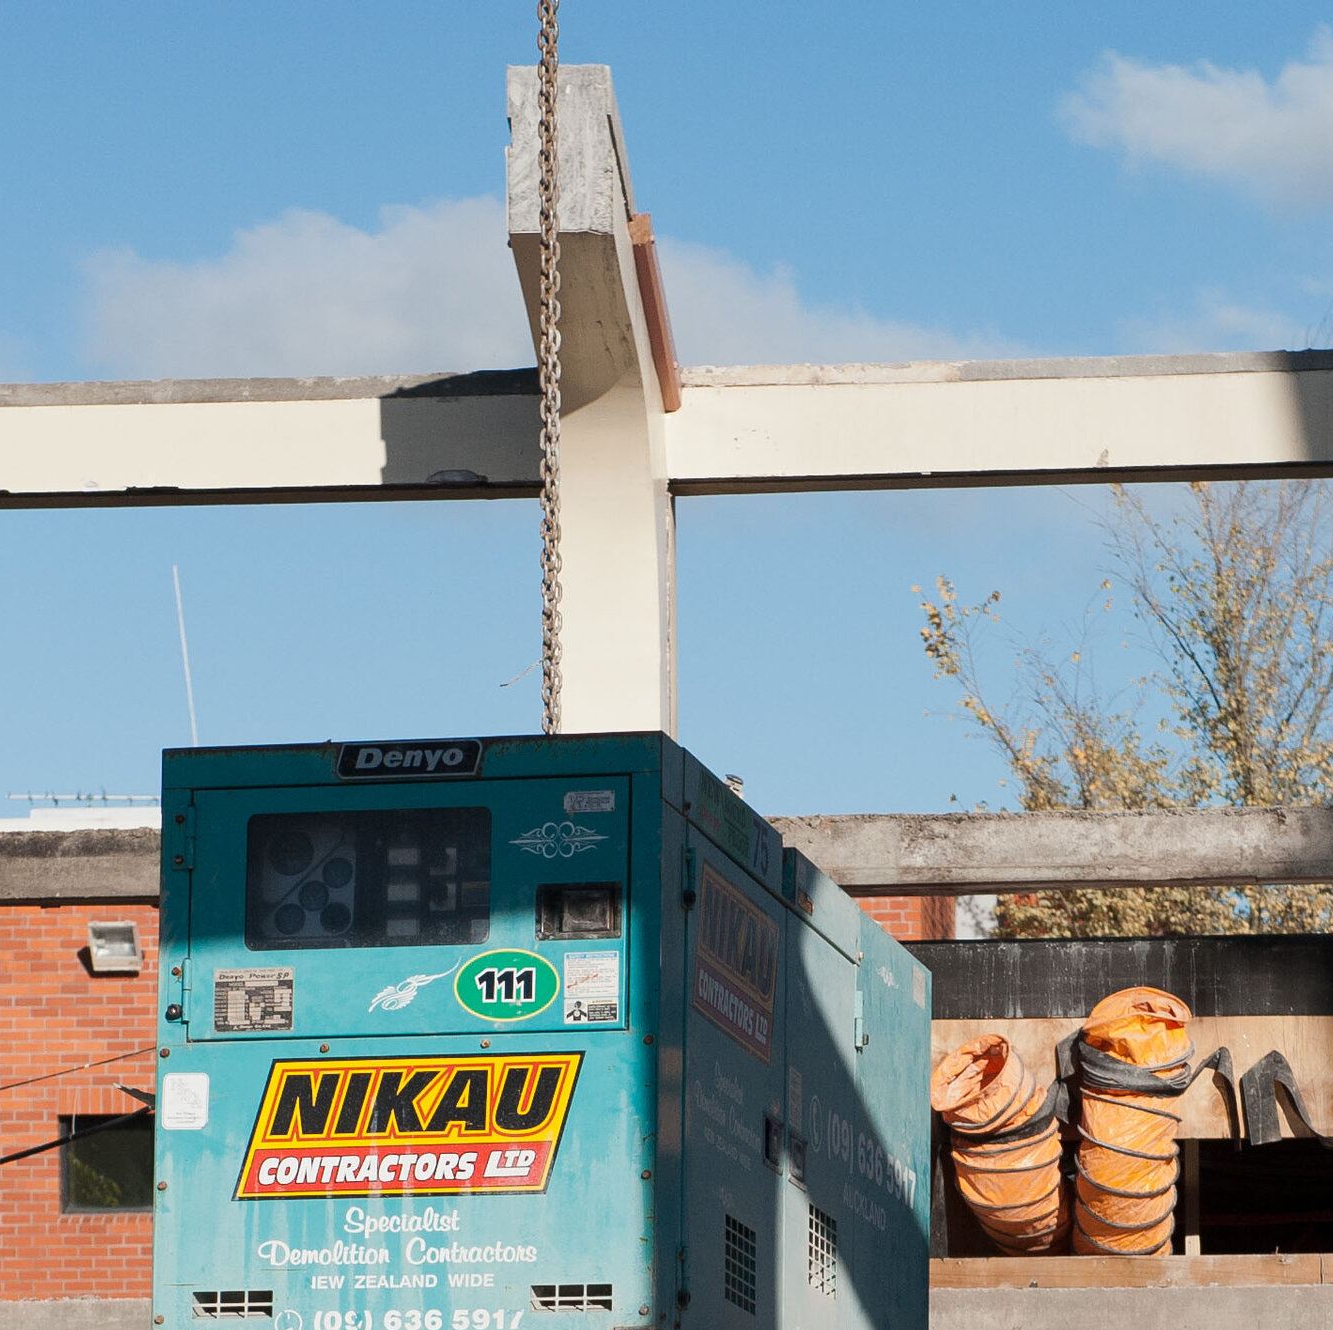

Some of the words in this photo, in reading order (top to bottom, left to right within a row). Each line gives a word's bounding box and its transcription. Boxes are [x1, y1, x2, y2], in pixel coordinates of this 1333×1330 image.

[356, 746, 463, 771] Denyo
[700, 878, 774, 997] NIKAU
[475, 968, 535, 1002] 111
[698, 969, 754, 1036] CONTRACTORS
[754, 1011, 768, 1045] LTD
[269, 1065, 563, 1137] NIKAU
[257, 1152, 478, 1187] CONTRACTORS
[483, 1149, 536, 1178] LTD
[827, 1109, 854, 1175] (09)
[857, 1131, 884, 1187] 636
[886, 1152, 916, 1210] 5917
[344, 1206, 461, 1238] Specialist
[843, 1181, 886, 1232] AUCKLAND
[257, 1239, 390, 1268] Demolition
[404, 1236, 538, 1265] Contractors
[353, 1274, 438, 1289] ZEALAND
[447, 1273, 495, 1288] WIDE
[451, 1308, 525, 1330] 5917
